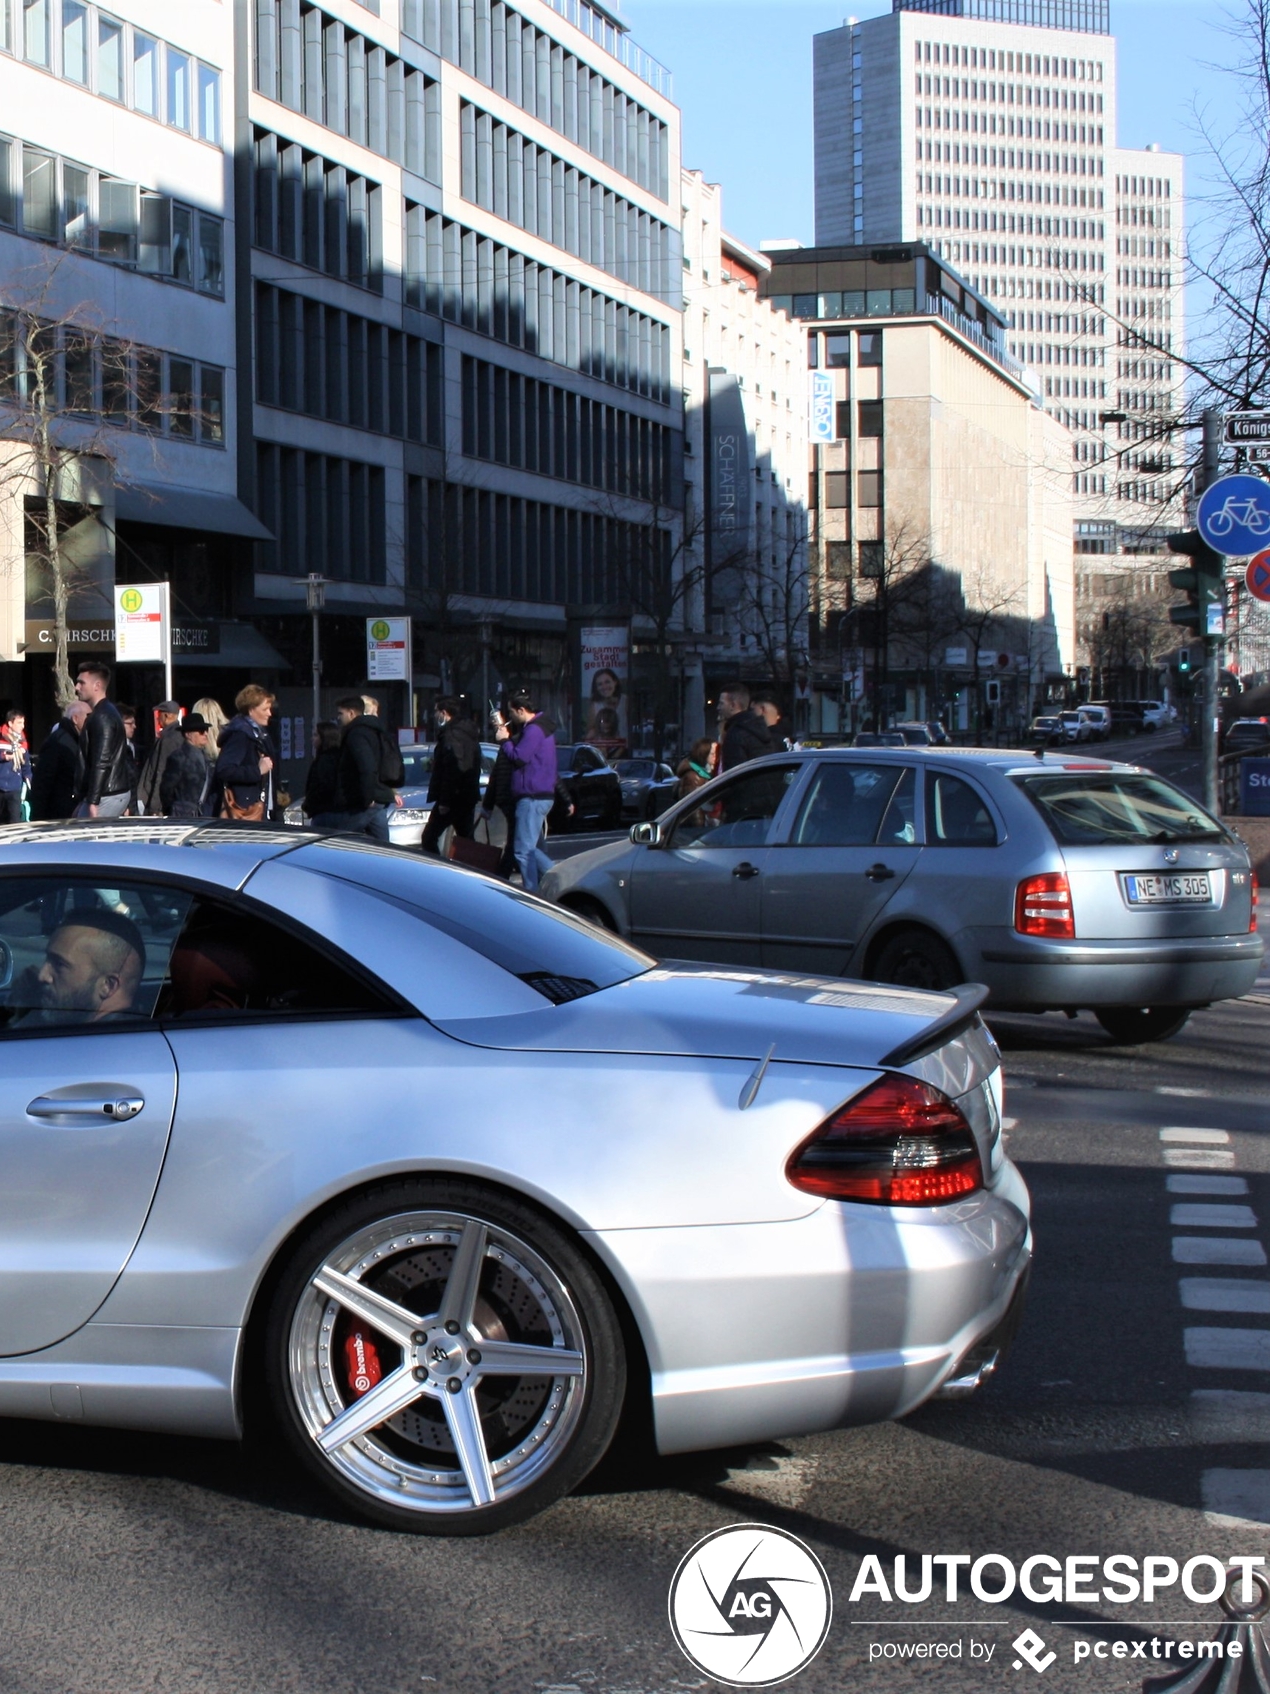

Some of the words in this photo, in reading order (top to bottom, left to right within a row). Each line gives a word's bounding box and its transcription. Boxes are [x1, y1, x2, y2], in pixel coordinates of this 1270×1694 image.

[814, 374, 832, 436] CABINET
[719, 435, 735, 539] SCHÄFFNER
[125, 593, 137, 608] H
[38, 630, 52, 642] C.
[171, 628, 209, 646] IRSCHKE
[593, 653, 619, 661] Stadt
[1249, 773, 1270, 787] St
[1138, 879, 1156, 896] NE
[1164, 879, 1182, 896] MS
[1184, 878, 1208, 895] 305
[354, 1333, 366, 1374] brembo
